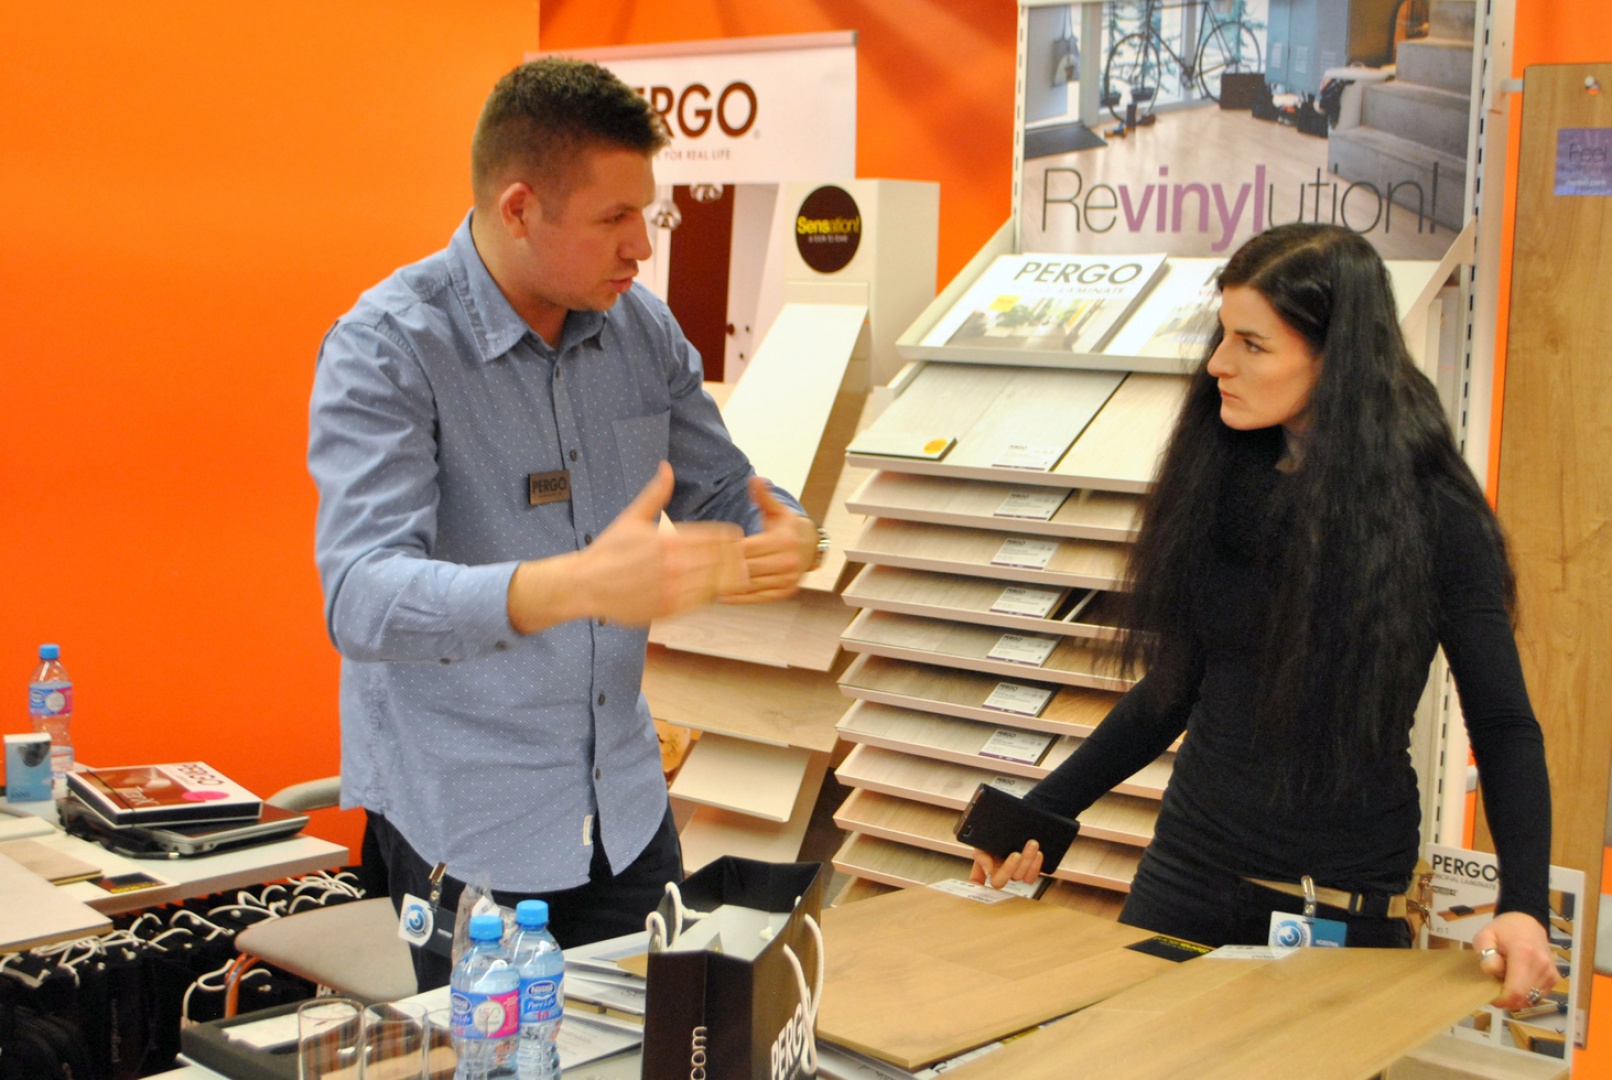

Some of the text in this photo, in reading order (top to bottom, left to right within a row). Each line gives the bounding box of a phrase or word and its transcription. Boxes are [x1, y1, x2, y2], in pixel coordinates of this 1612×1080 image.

[637, 81, 758, 139] RGO
[664, 150, 682, 161] FOR
[686, 149, 708, 161] REAL
[711, 148, 731, 160] LIFE
[1041, 162, 1439, 252] Revinylution!
[797, 215, 860, 234] Sensation!
[1013, 261, 1144, 285] PERGO
[1059, 286, 1125, 296] LAMINATE
[532, 476, 567, 494] PERGO
[1432, 853, 1499, 882] PERGO
